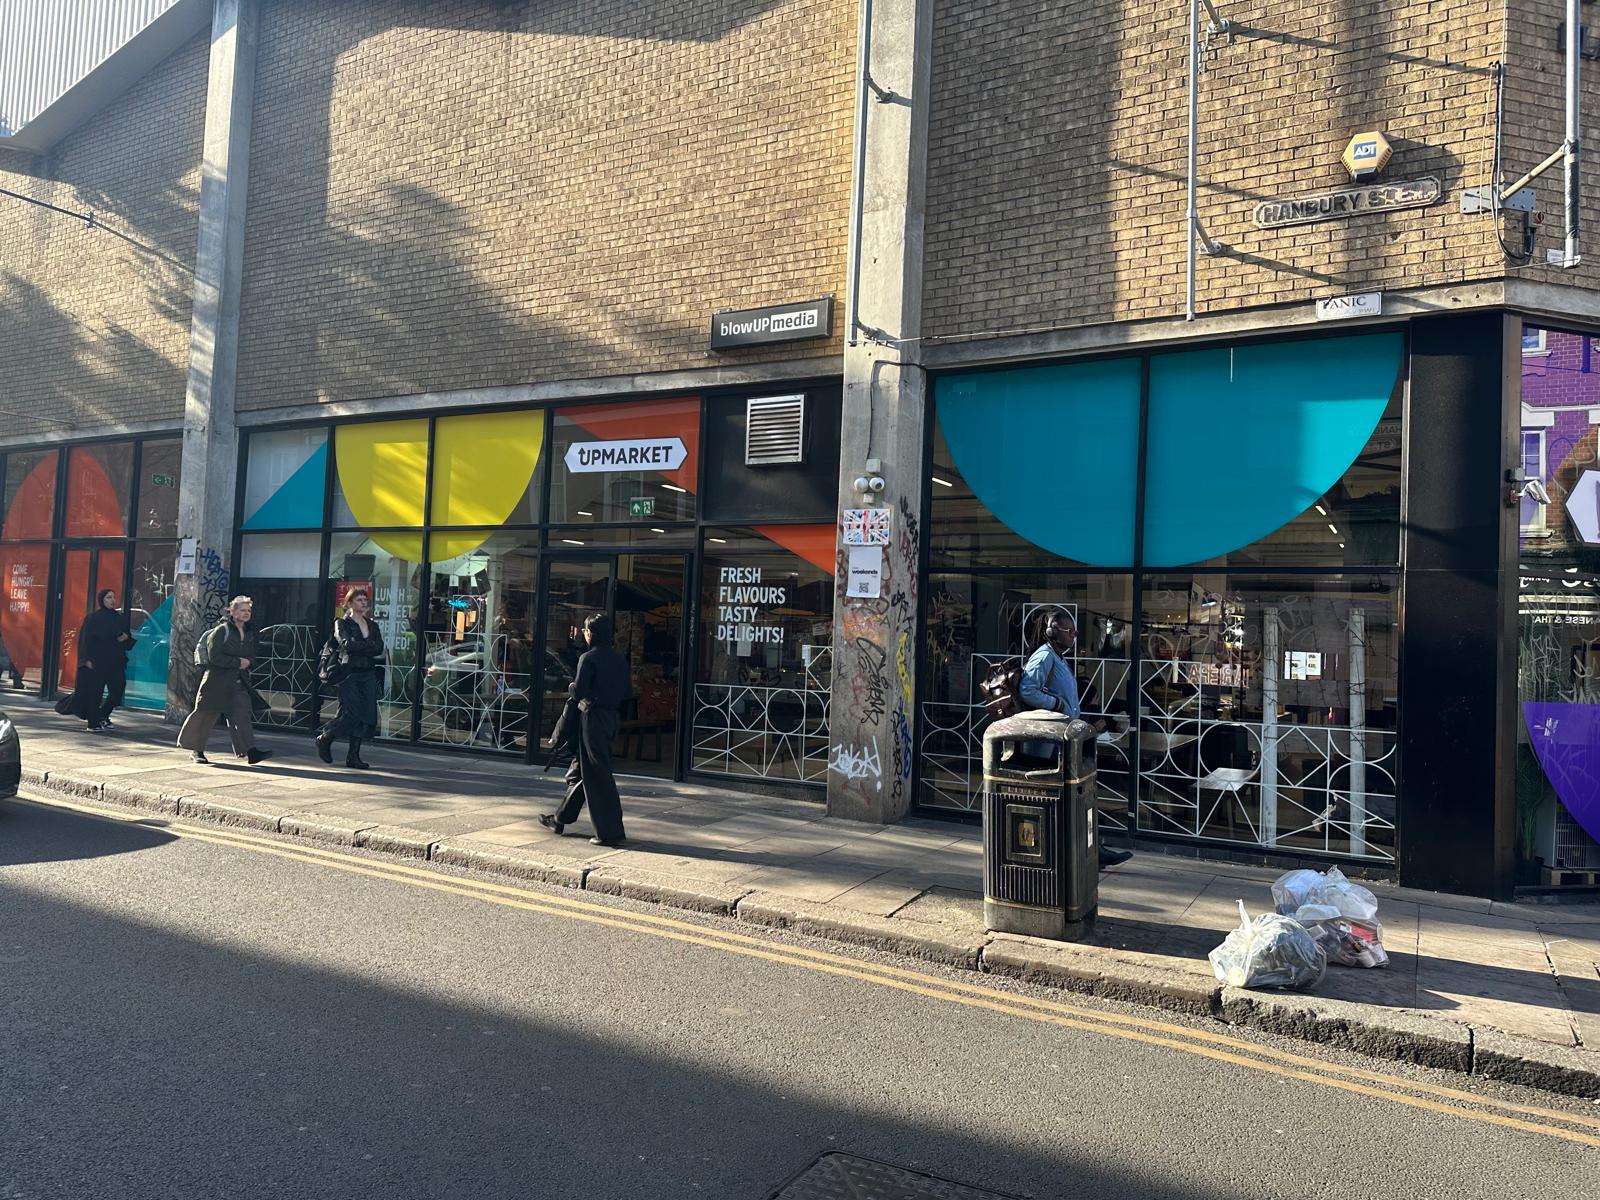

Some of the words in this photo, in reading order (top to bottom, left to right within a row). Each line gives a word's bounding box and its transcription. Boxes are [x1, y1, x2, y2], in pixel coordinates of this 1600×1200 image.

[1355, 143, 1377, 157] ADT
[1263, 192, 1361, 223] HANBURY
[577, 445, 673, 466] UPMARKET
[720, 567, 762, 584] FRESH
[10, 588, 28, 600] LEAVE
[719, 586, 786, 604] FLAVOURS
[718, 606, 759, 623] TASTY
[717, 625, 784, 644] DELIGHTS!
